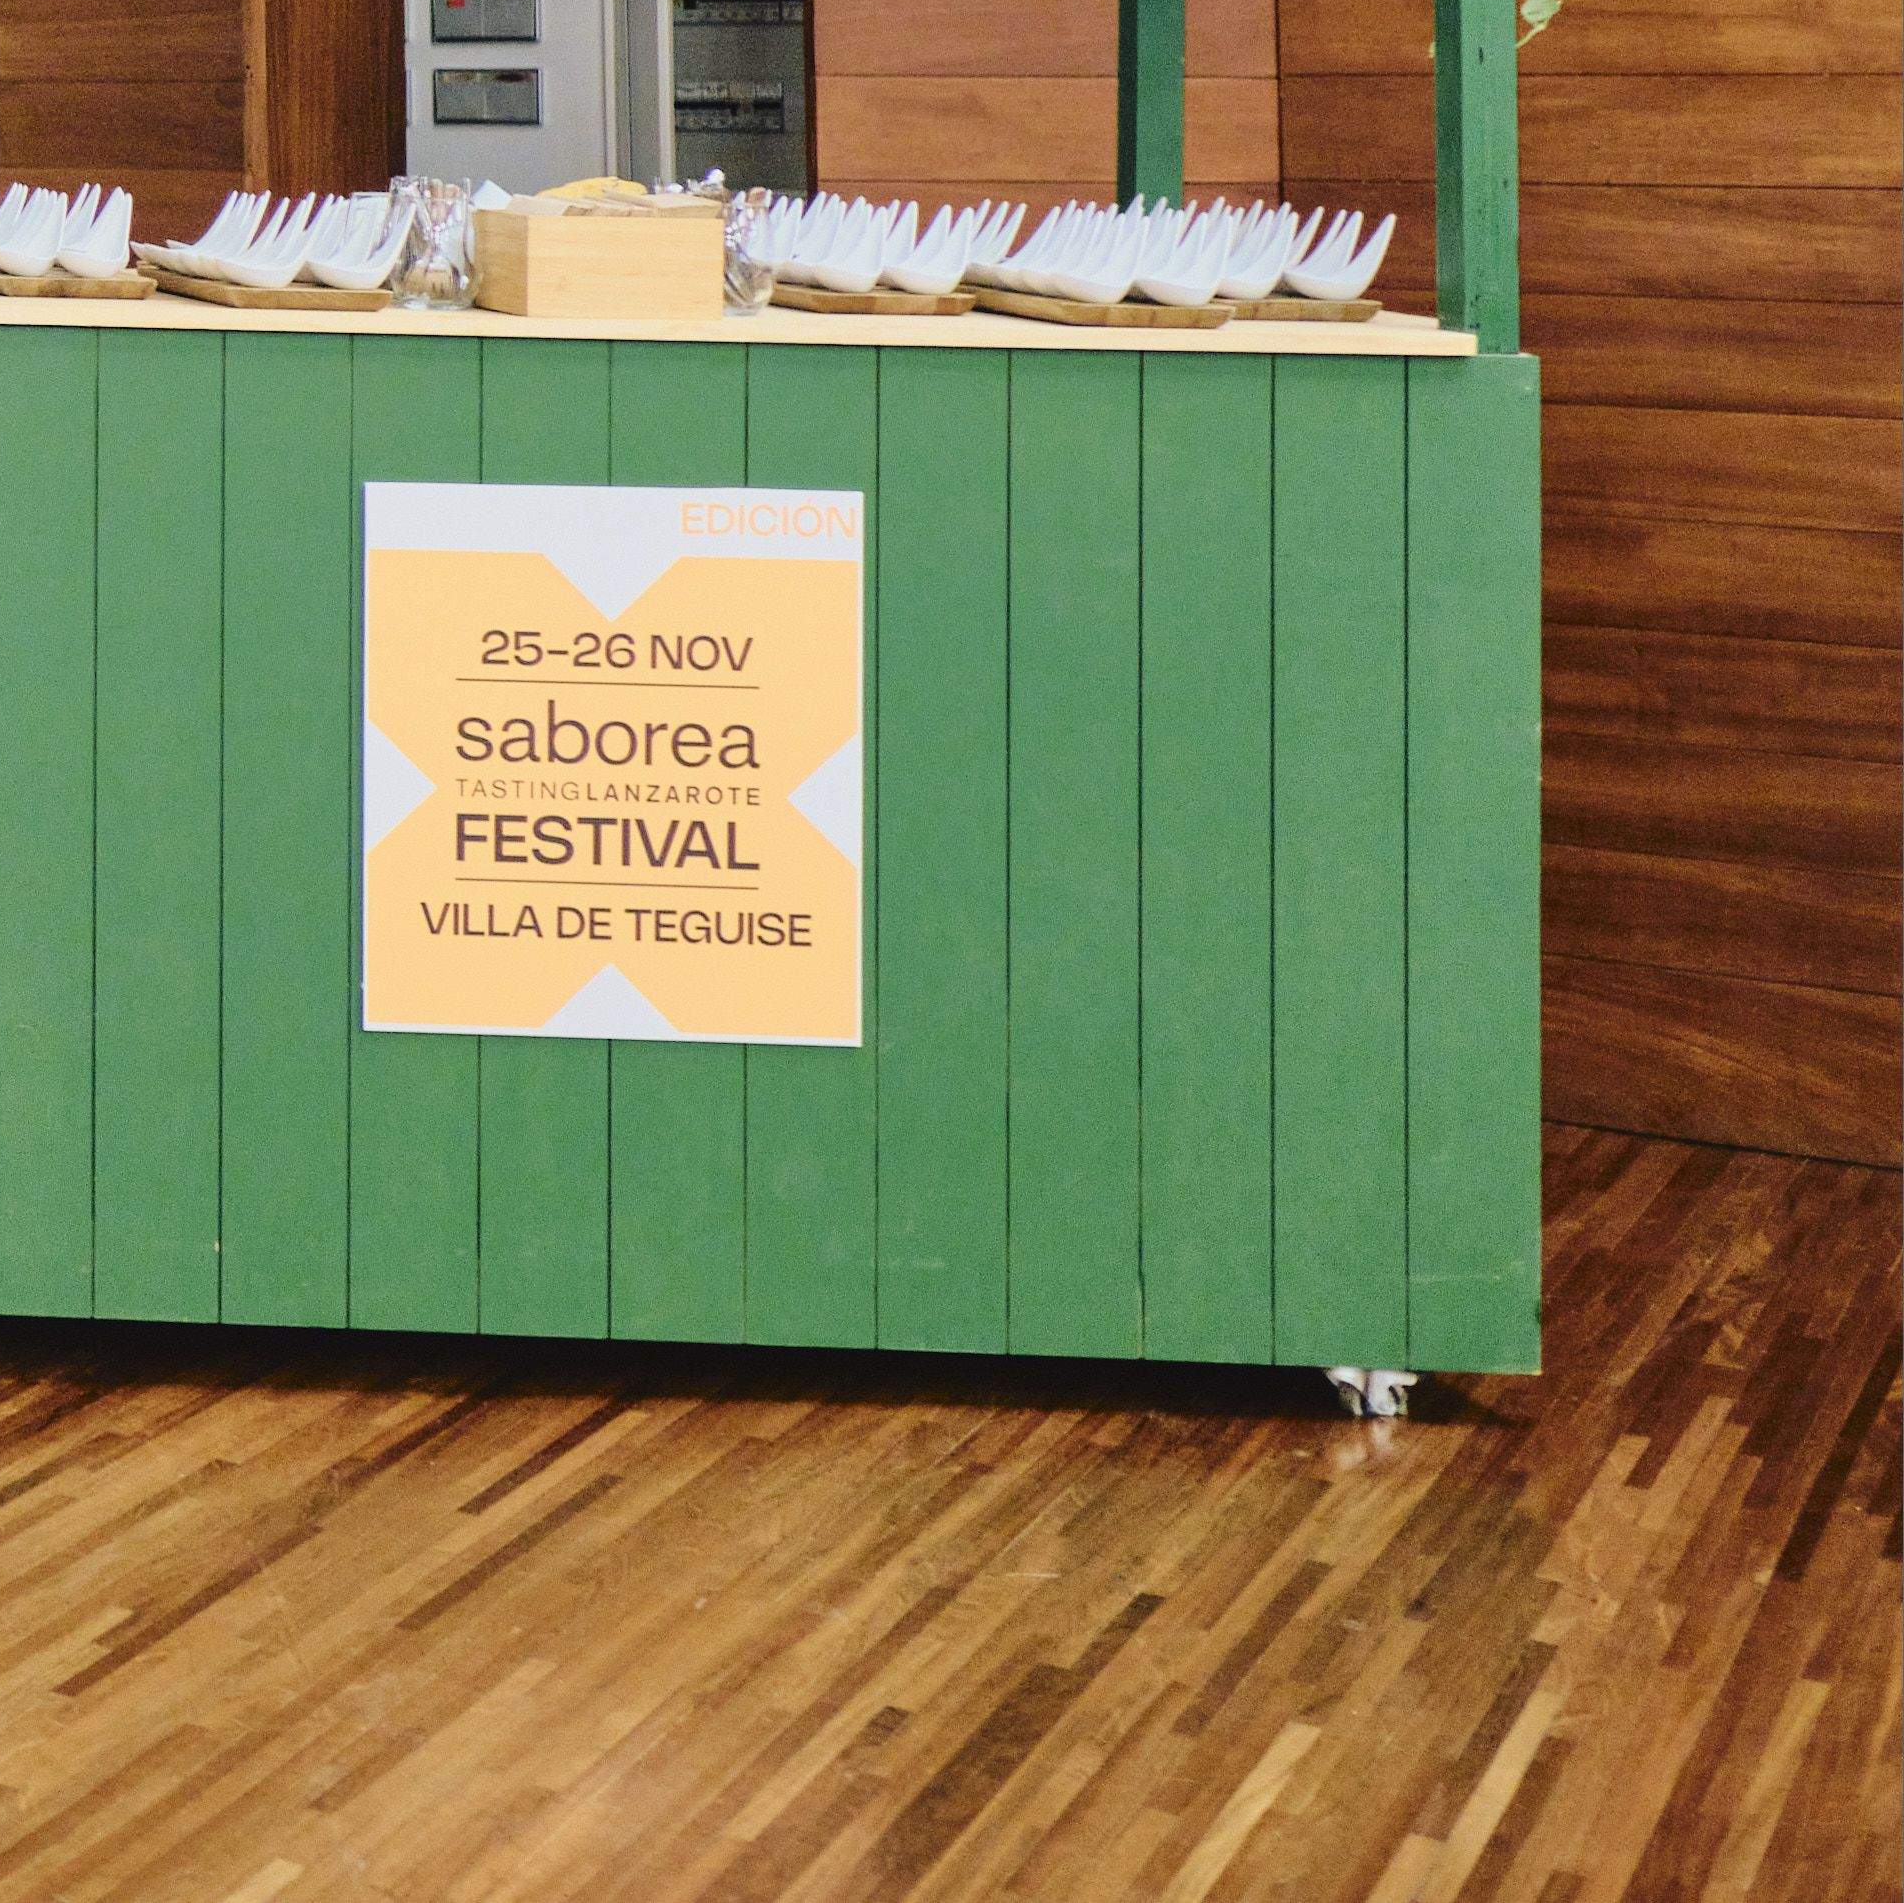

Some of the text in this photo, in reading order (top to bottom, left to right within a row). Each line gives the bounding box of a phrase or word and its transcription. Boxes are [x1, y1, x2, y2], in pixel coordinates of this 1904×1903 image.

[680, 497, 856, 539] EDICIÓN
[480, 629, 754, 672] 25-26 NOV
[455, 699, 760, 769] saborea
[455, 778, 761, 807] TASTINGLANZAROTE
[455, 813, 760, 871] FESTIVAL
[420, 902, 812, 948] VILLA DE TEGUISE
